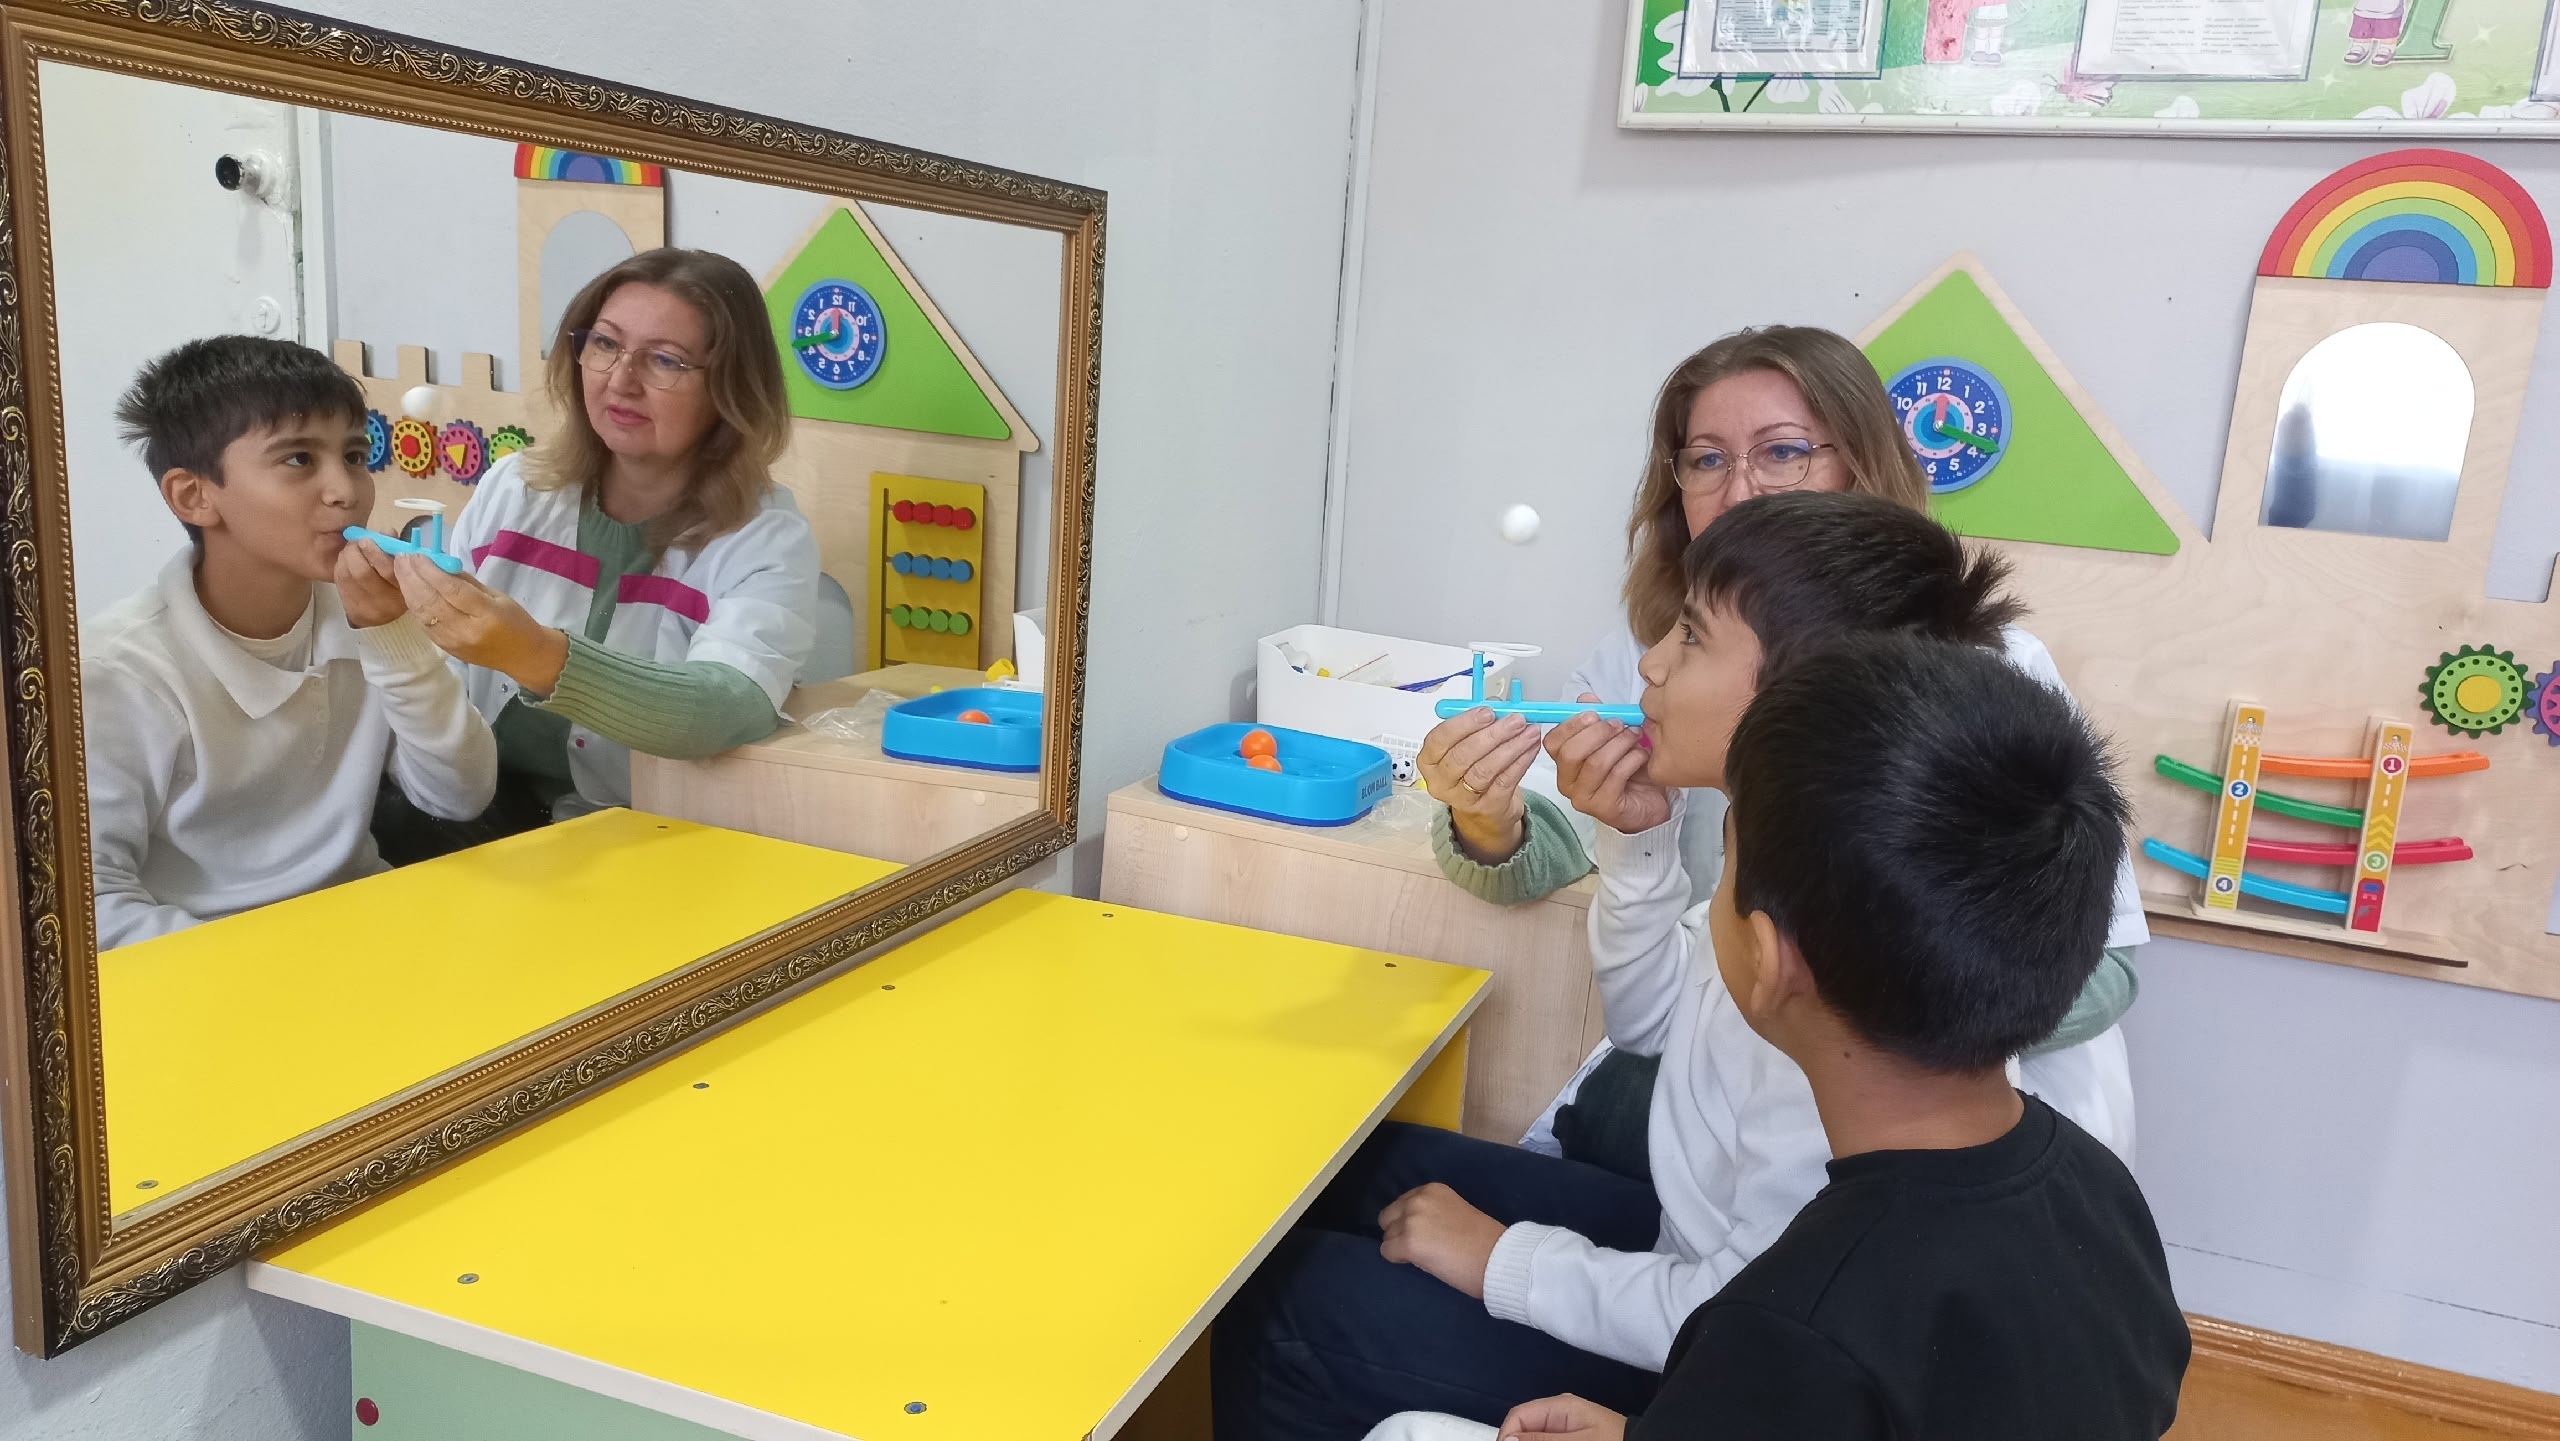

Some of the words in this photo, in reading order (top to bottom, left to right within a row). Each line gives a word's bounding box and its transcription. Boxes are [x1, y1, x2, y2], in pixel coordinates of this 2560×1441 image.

[1916, 381, 1928, 396] 11
[1937, 376, 1952, 390] 12
[1965, 385, 1970, 398] 1
[1897, 397, 1912, 410] 10
[1974, 400, 1986, 414] 2
[1976, 422, 1987, 436] 3
[1967, 445, 1978, 458] 4
[1926, 461, 1937, 475] 6
[1949, 457, 1960, 471] 5
[2388, 760, 2396, 771] 1
[2235, 784, 2245, 795] 2
[2371, 856, 2380, 867] 3
[2218, 879, 2229, 890] 4
